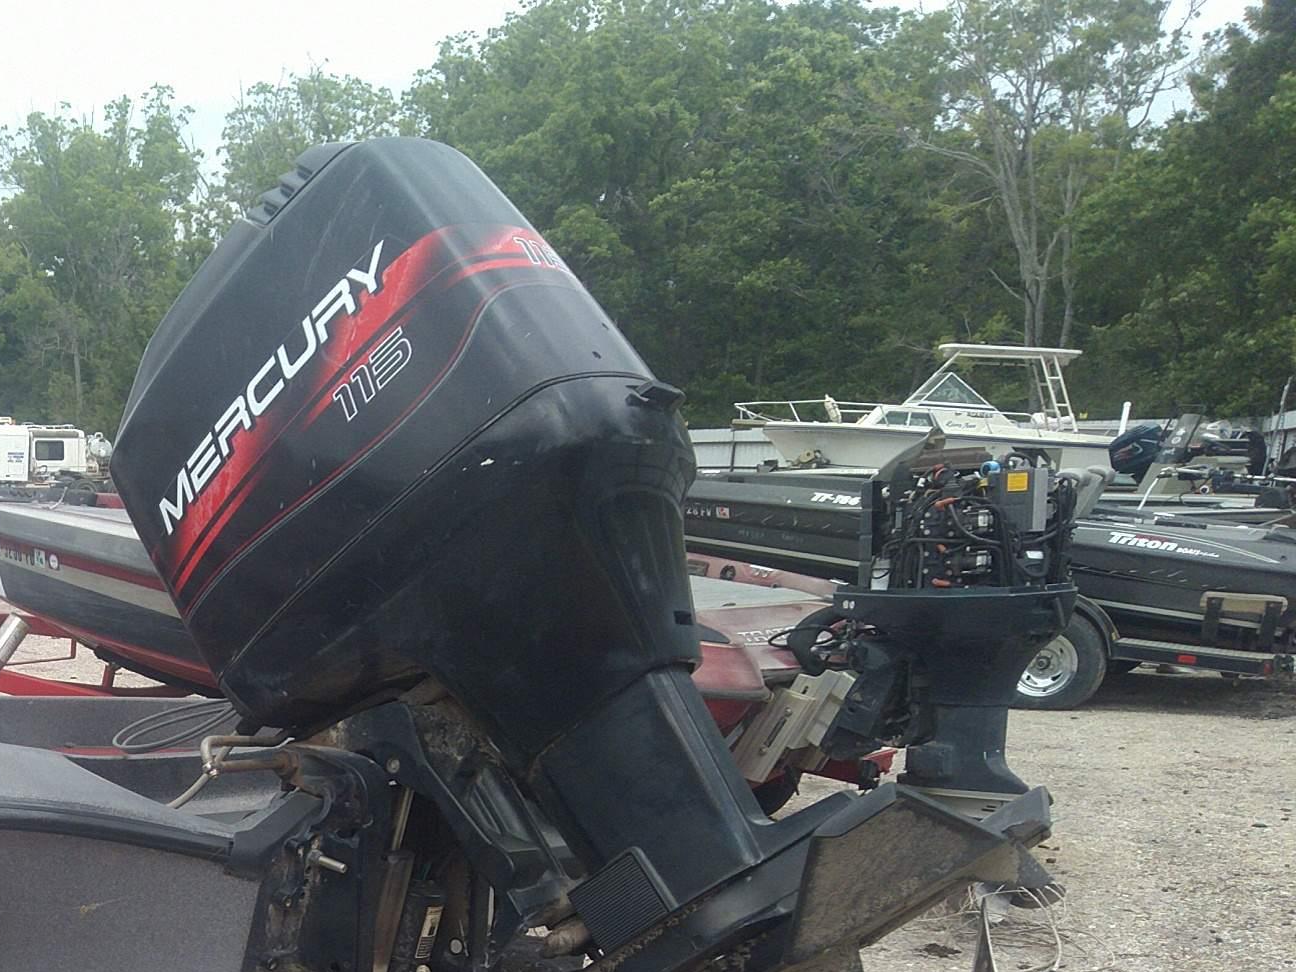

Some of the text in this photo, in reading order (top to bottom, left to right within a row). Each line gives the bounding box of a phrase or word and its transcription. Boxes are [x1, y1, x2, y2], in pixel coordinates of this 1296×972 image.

[159, 239, 384, 535] MERCURY
[332, 326, 412, 422] 115
[1108, 531, 1178, 551] Triton
